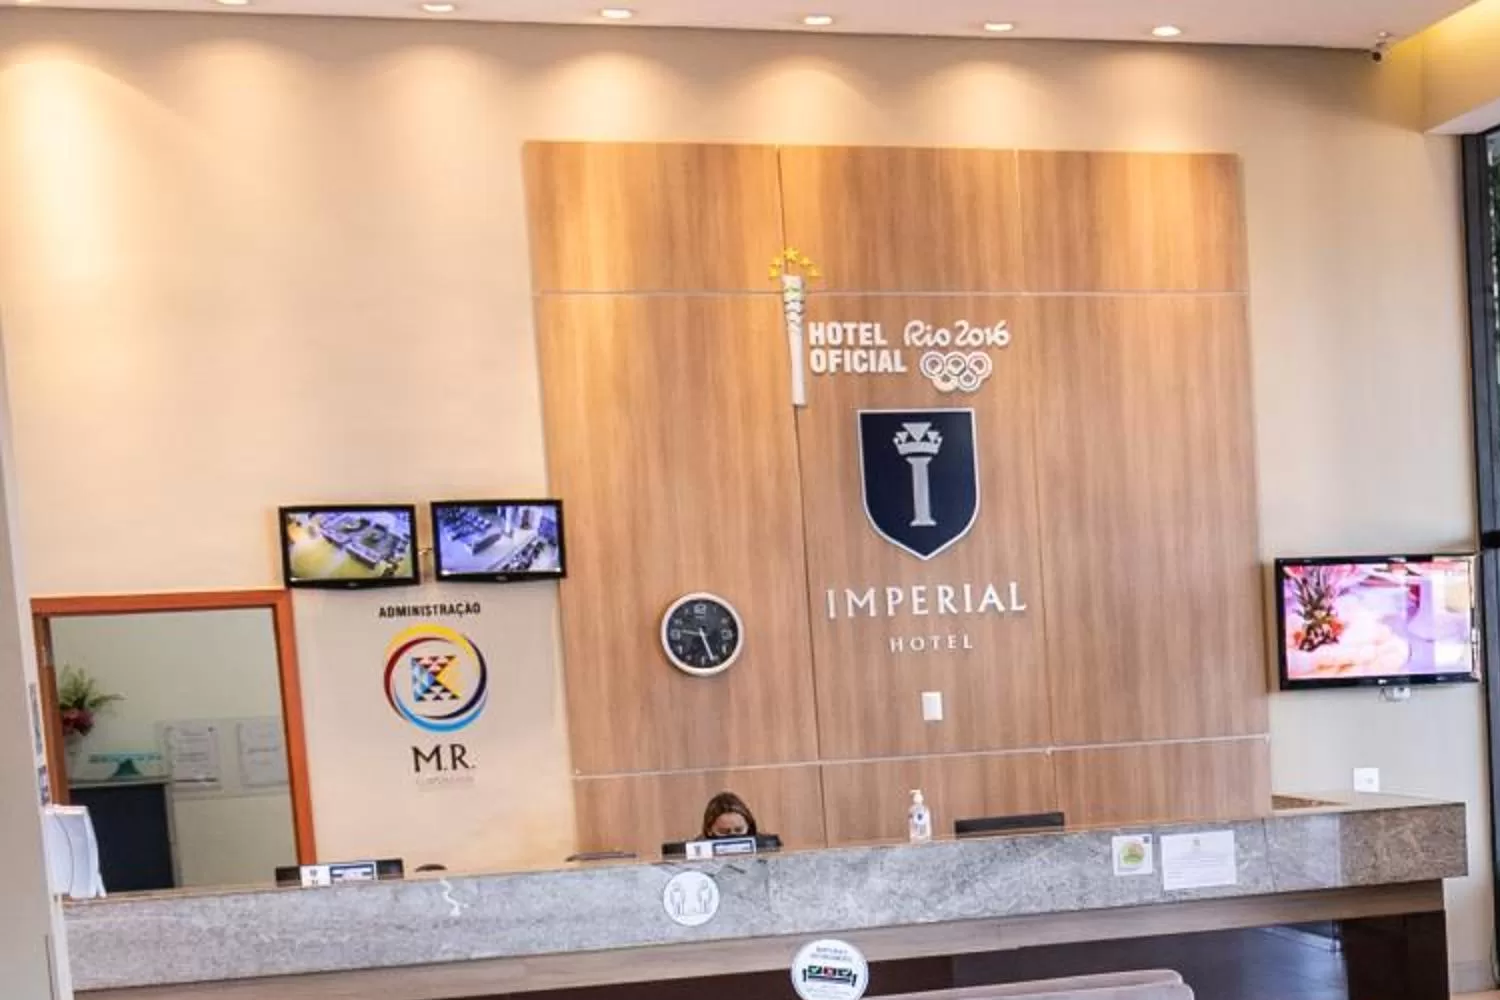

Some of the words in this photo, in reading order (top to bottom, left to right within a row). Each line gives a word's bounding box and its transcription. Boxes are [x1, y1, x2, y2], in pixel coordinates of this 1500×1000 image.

[808, 321, 888, 346] HOTEL
[903, 319, 951, 347] Rio
[954, 319, 1010, 346] 2016
[809, 350, 907, 376] OFICIAL
[826, 581, 1027, 619] IMPERIAL
[889, 633, 973, 653] HOTEL
